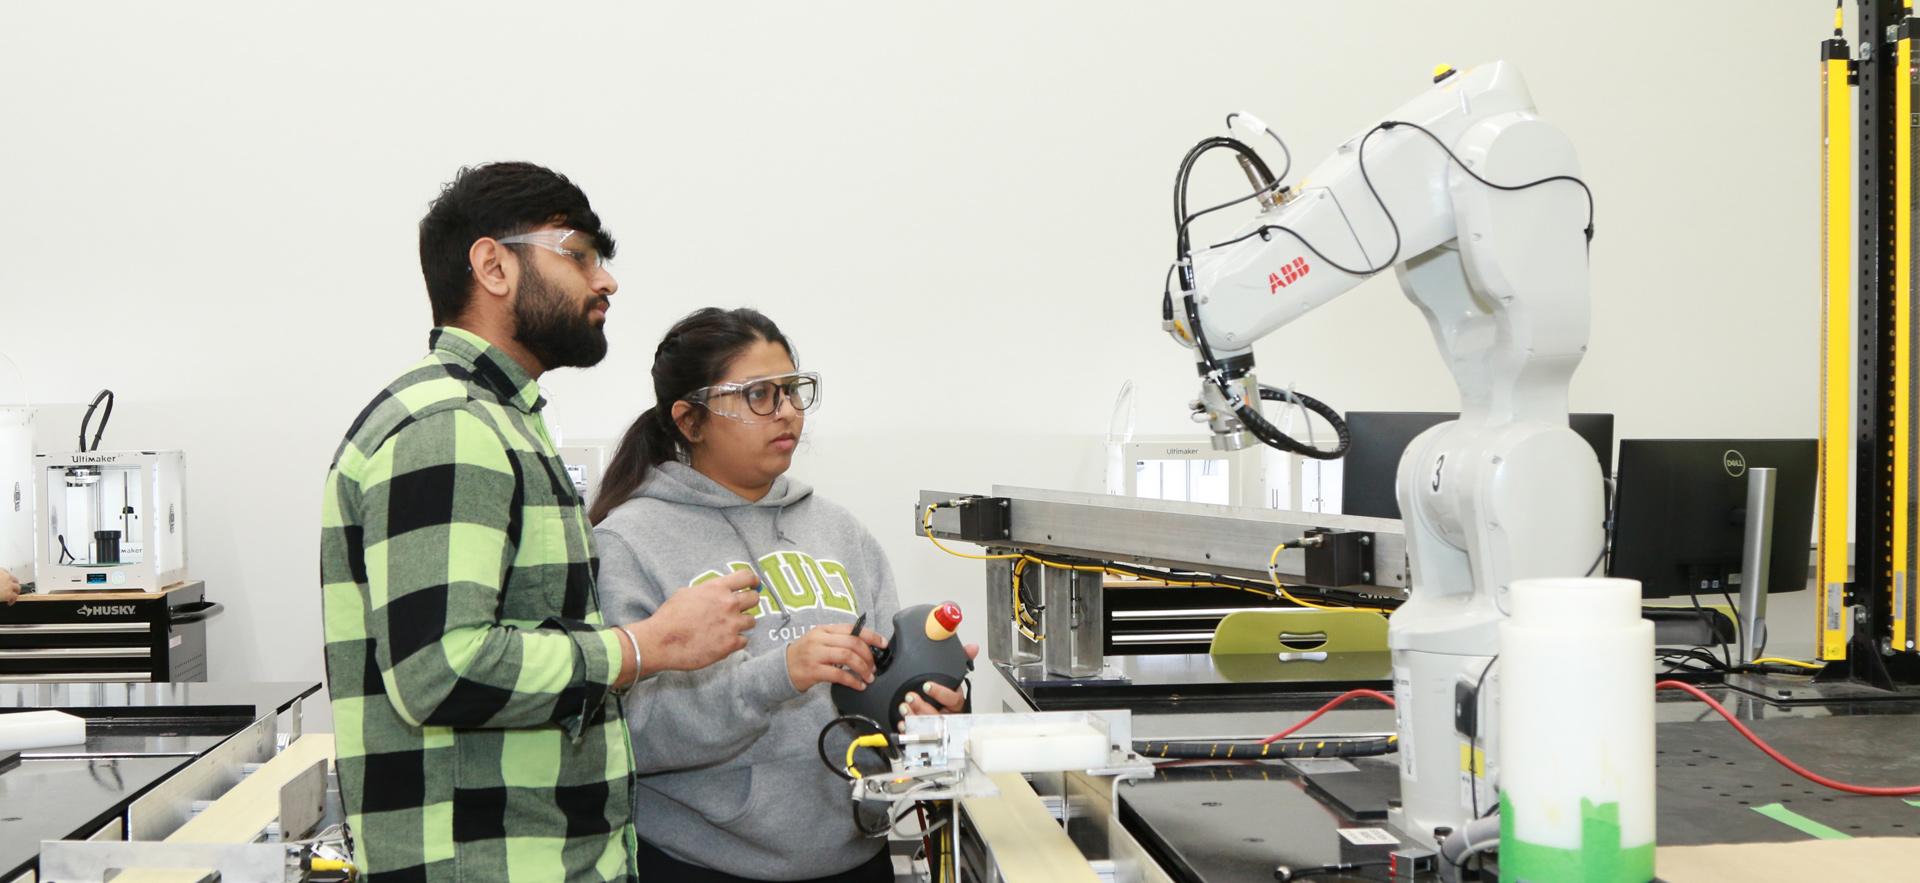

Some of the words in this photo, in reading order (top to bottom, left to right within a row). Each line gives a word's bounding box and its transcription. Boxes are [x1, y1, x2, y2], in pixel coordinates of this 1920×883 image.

[1269, 256, 1310, 295] ABB
[71, 455, 116, 463] Ultimaker
[1726, 459, 1744, 467] DELL
[1432, 454, 1445, 493] 3
[92, 605, 136, 616] HUSKY
